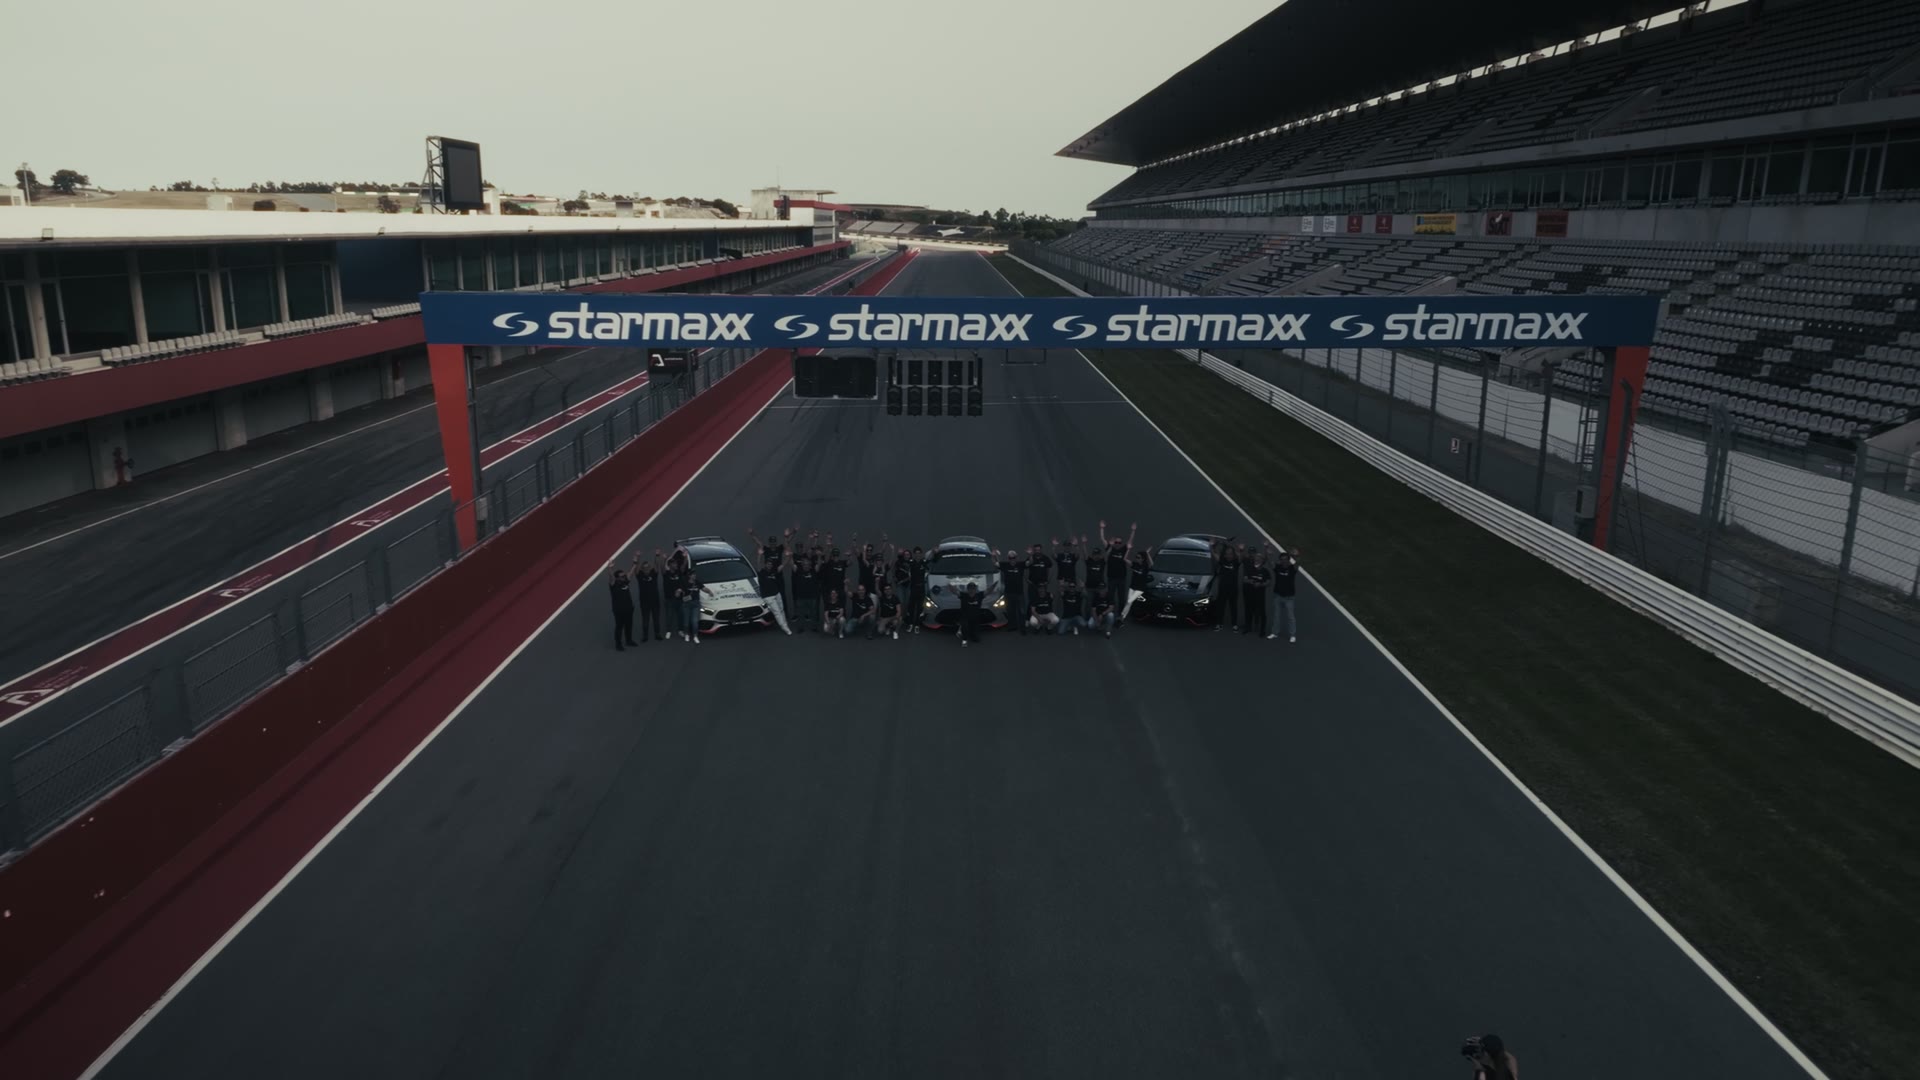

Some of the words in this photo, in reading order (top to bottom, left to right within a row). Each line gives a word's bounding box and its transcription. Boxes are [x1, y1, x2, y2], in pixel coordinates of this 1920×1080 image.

[547, 302, 755, 341] starmaxx
[828, 303, 1033, 341] starmaxx
[1105, 304, 1311, 342] starmaxx
[1382, 304, 1588, 341] starmaxx
